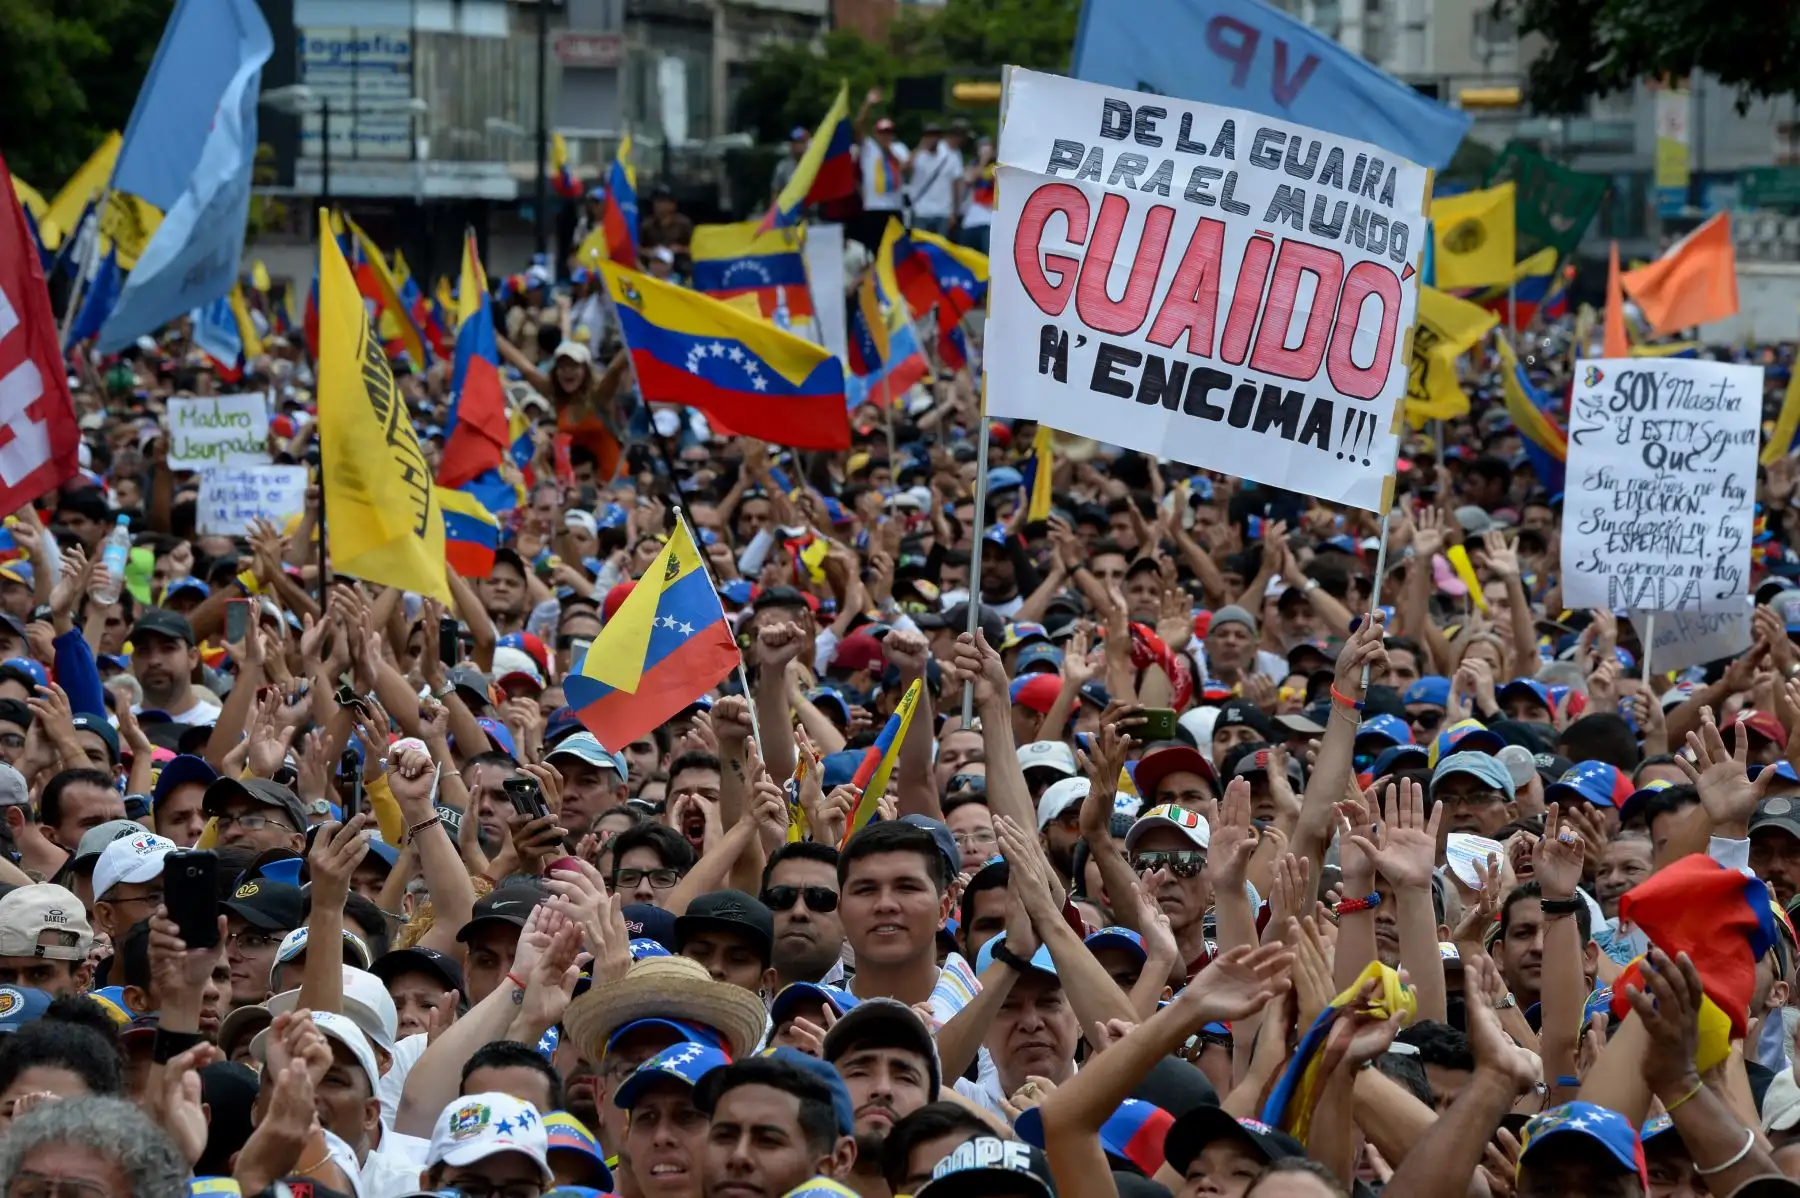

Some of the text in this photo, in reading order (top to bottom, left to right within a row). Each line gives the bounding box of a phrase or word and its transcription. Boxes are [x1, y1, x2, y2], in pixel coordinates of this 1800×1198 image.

[1100, 97, 1168, 148] DE
[1174, 111, 1237, 161] LA
[1045, 138, 1410, 264] PARA EL MUNDO
[1609, 370, 1743, 413] SOY Maestra
[178, 401, 252, 429] Maduro
[1614, 415, 1633, 445] Y
[1640, 420, 1699, 443] ESTOY
[1583, 465, 1619, 491] Sin
[1721, 473, 1750, 511] hay
[1577, 507, 1615, 535] Sin
[1576, 548, 1612, 575] Sin
[1714, 554, 1745, 600] hay
[1608, 576, 1702, 612] NADA
[44, 914, 68, 924] OAKLEY
